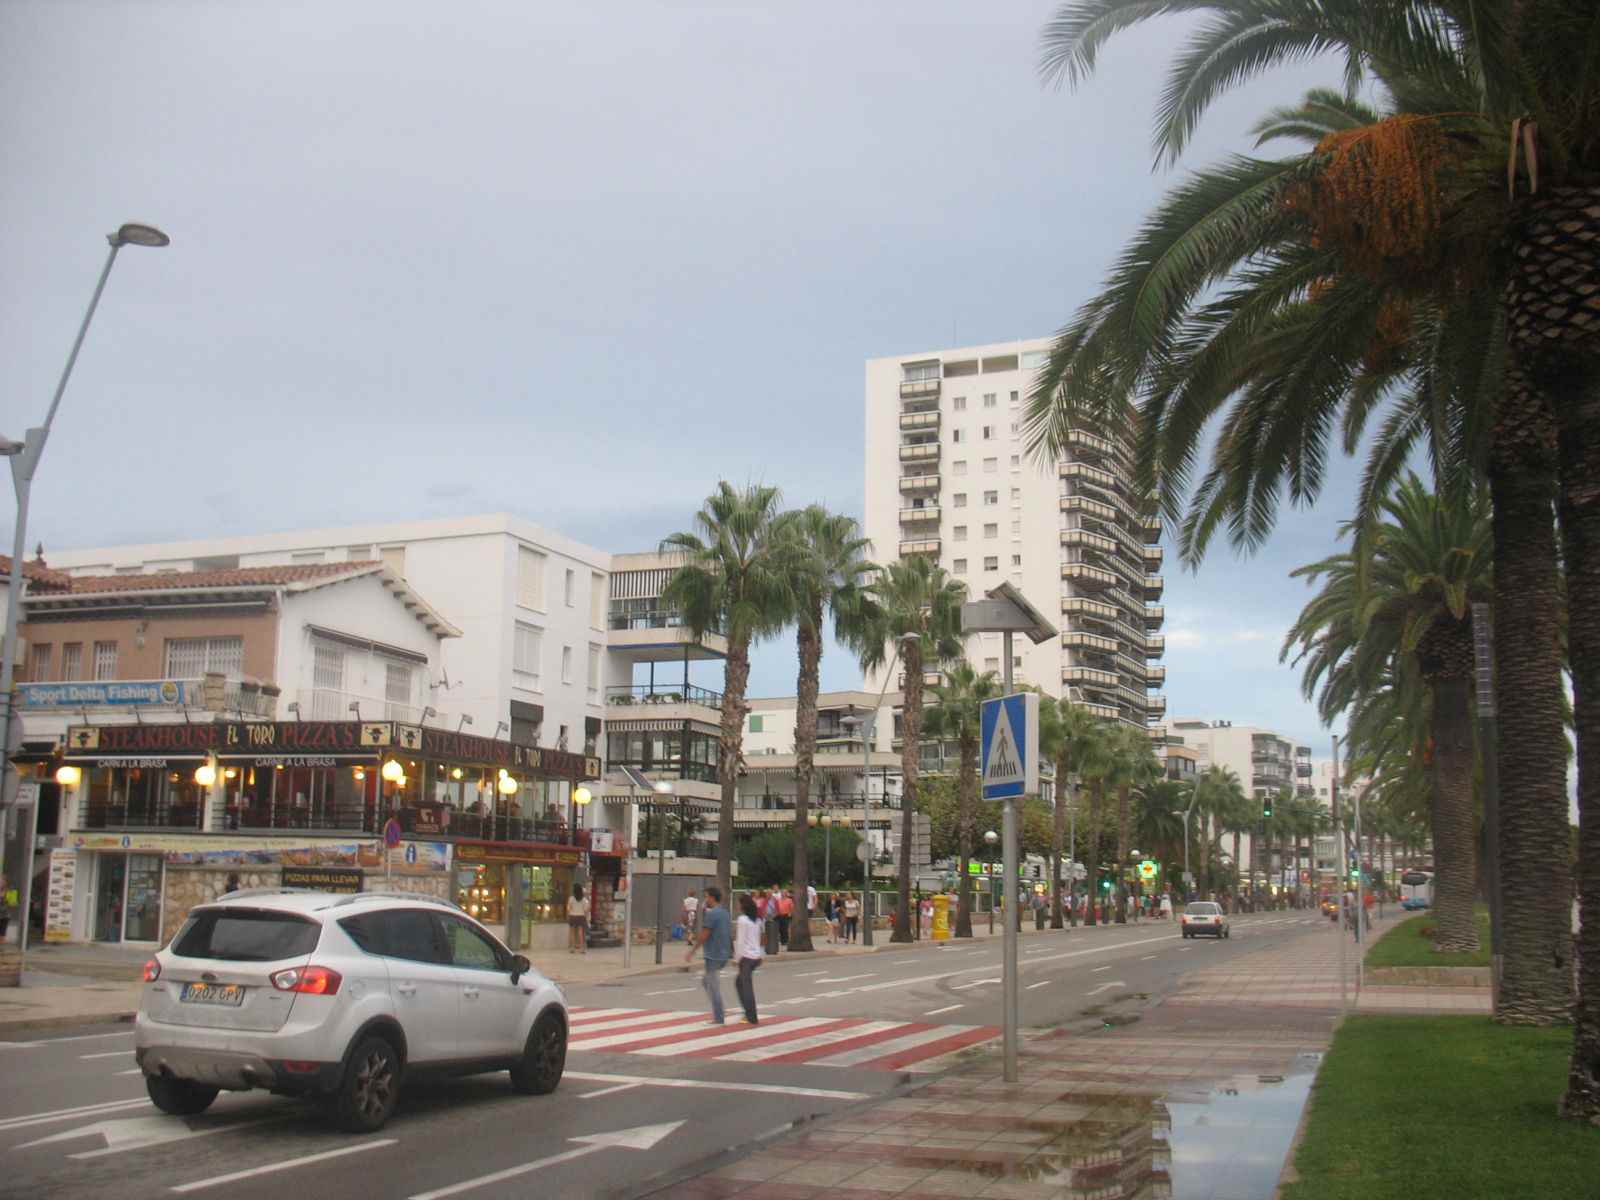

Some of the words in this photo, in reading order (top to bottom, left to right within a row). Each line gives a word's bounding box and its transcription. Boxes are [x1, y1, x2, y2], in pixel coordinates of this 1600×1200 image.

[29, 687, 66, 704] Sport
[69, 686, 105, 701] Delta
[108, 685, 158, 702] Fishing
[100, 725, 217, 750] STEAKHOUSE
[246, 724, 275, 745] TORO
